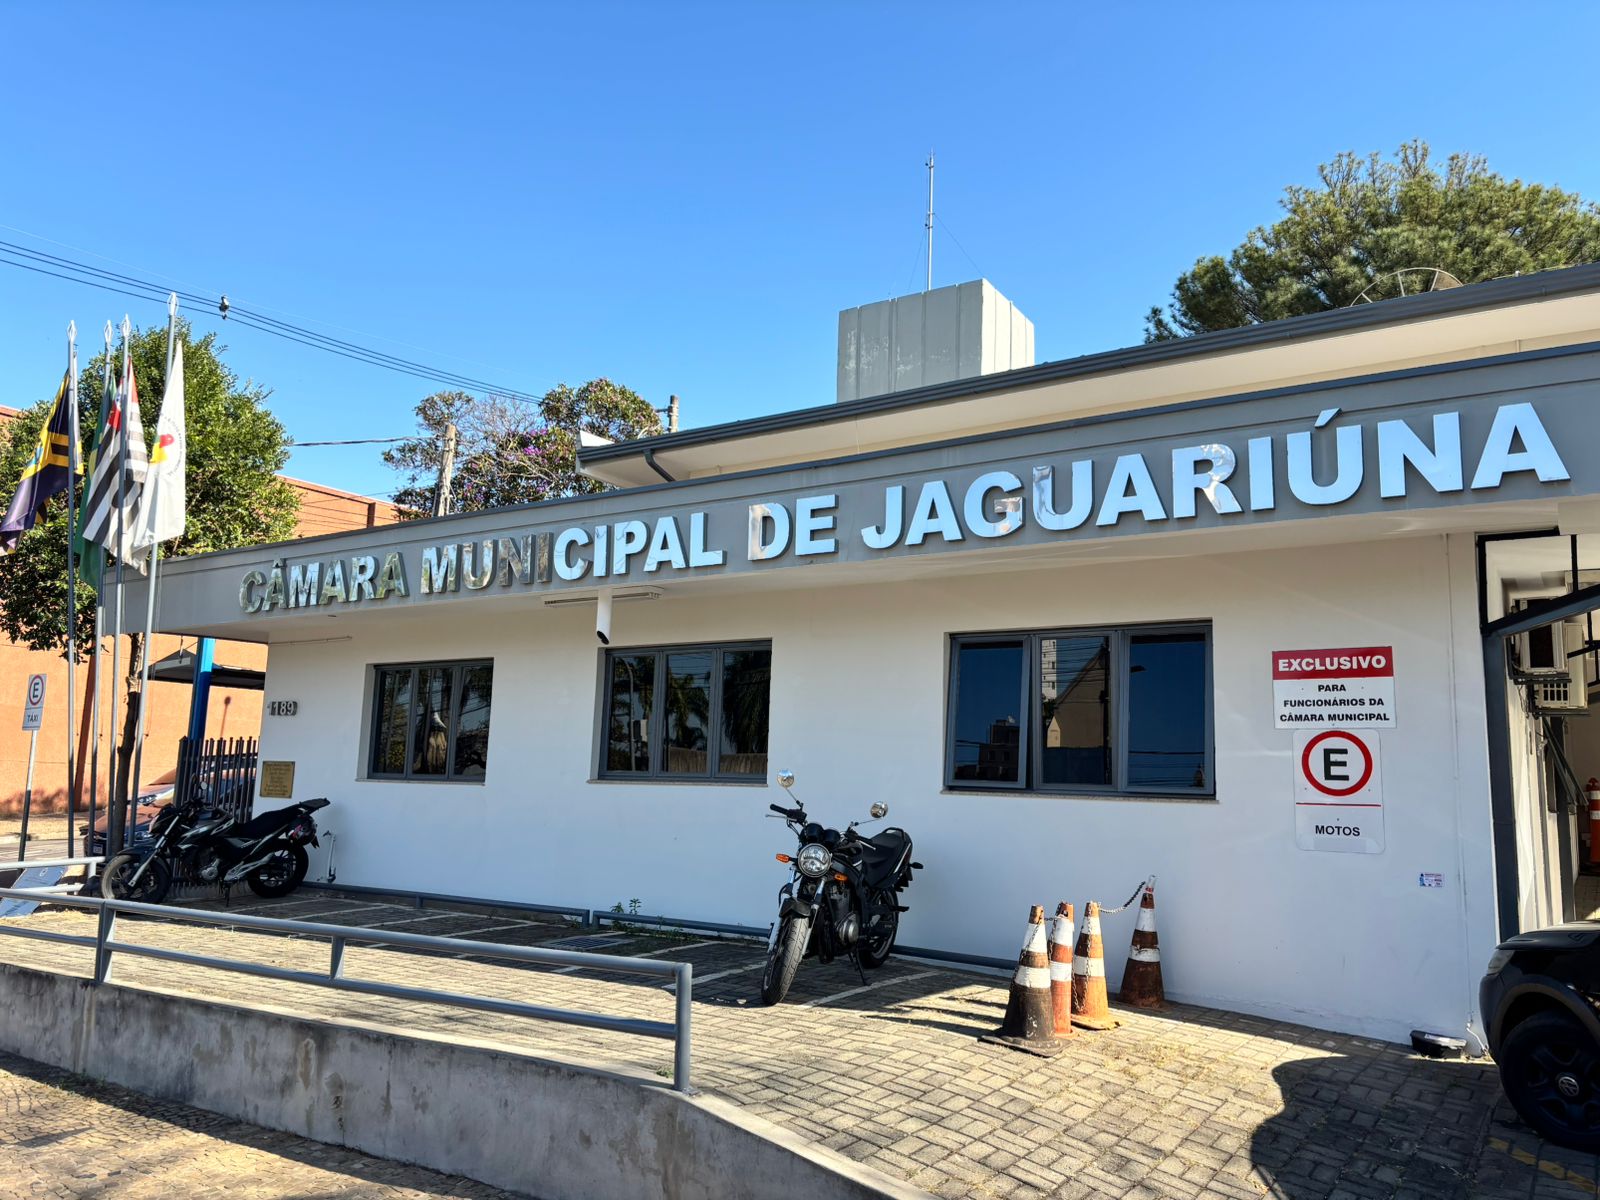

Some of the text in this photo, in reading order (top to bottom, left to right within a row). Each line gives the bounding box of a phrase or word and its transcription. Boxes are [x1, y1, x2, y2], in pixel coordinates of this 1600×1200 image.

[239, 401, 1570, 613] CÂMARA MUNICIPAL DE JAGUARIÚNA
[1278, 655, 1386, 671] EXCLUSIVO
[33, 682, 39, 698] E
[1317, 684, 1346, 692] PARA
[1283, 697, 1384, 707] FUNCIONÁRIOS DA
[1280, 712, 1389, 722] CÂMARA MUNICIPAL
[1323, 748, 1349, 781] E
[1315, 825, 1360, 836] MOTOS
